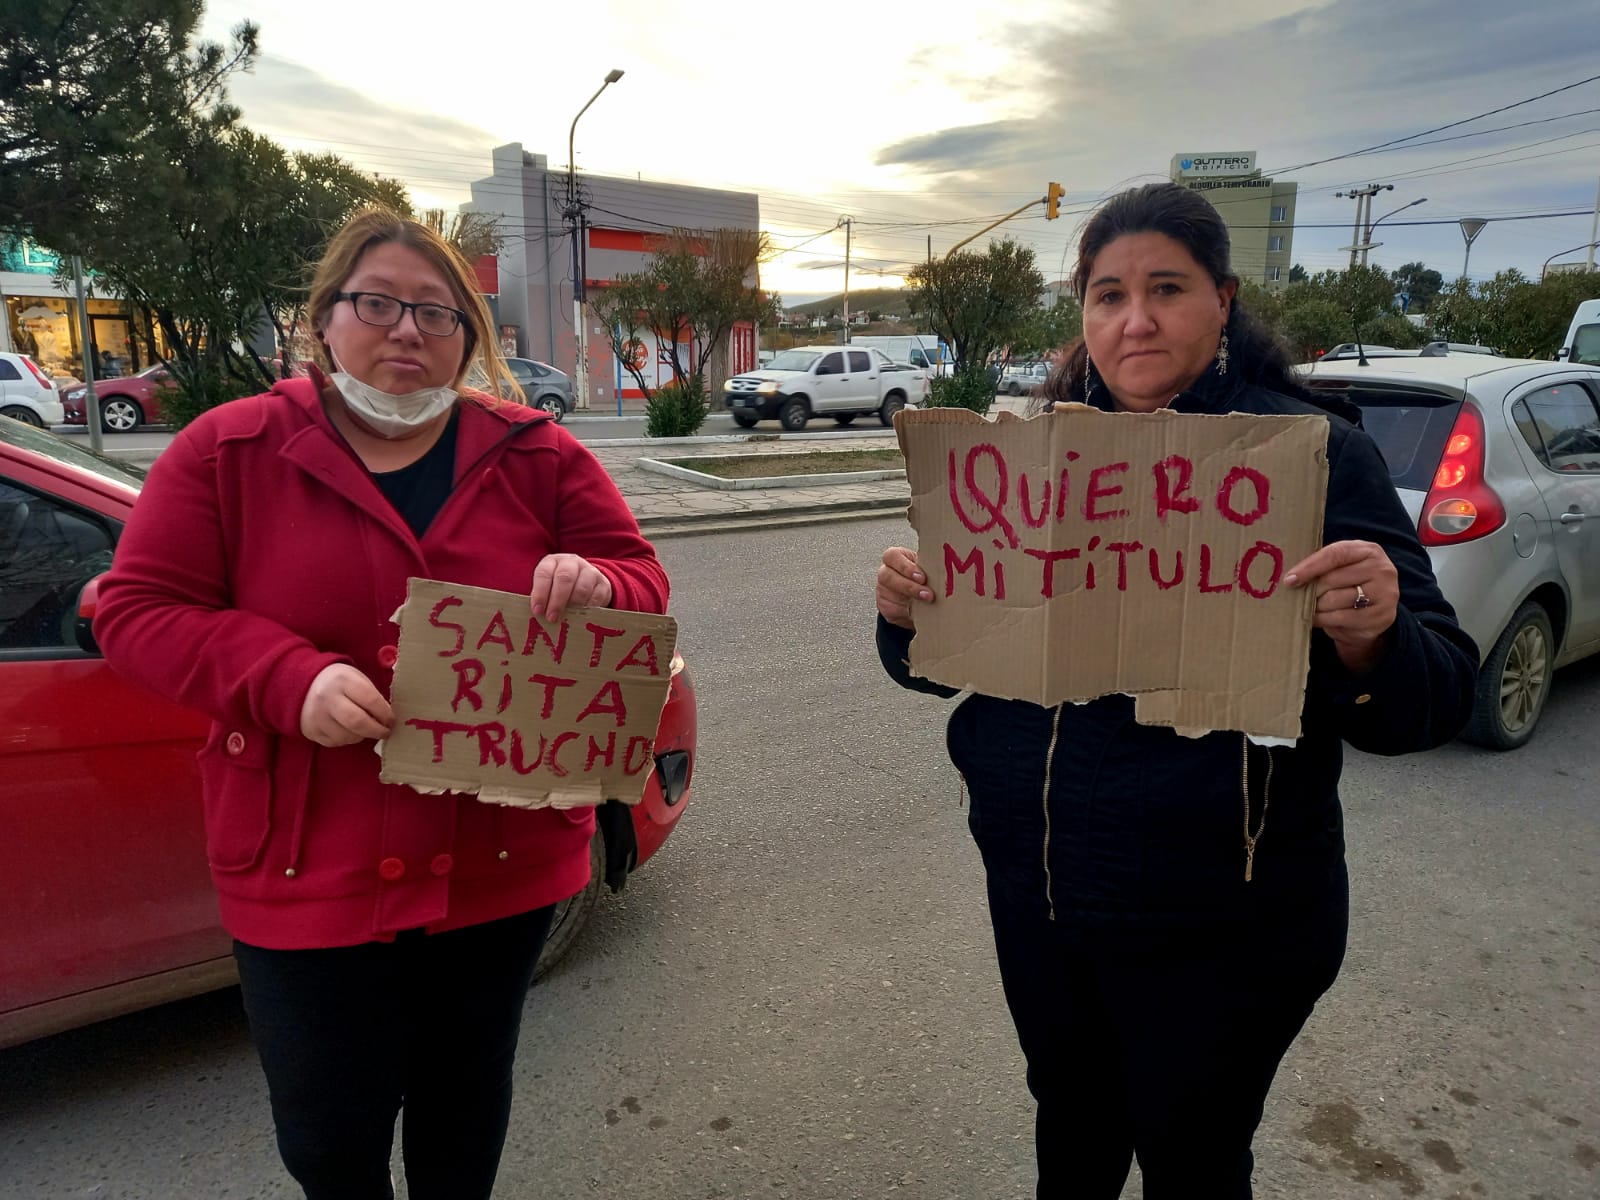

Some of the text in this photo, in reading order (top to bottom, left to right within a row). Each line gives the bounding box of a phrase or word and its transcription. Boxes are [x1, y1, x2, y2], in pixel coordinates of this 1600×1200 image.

[1193, 157, 1249, 165] GUTTERO
[428, 595, 660, 676] SANTA
[404, 718, 654, 777] TRUCHO
